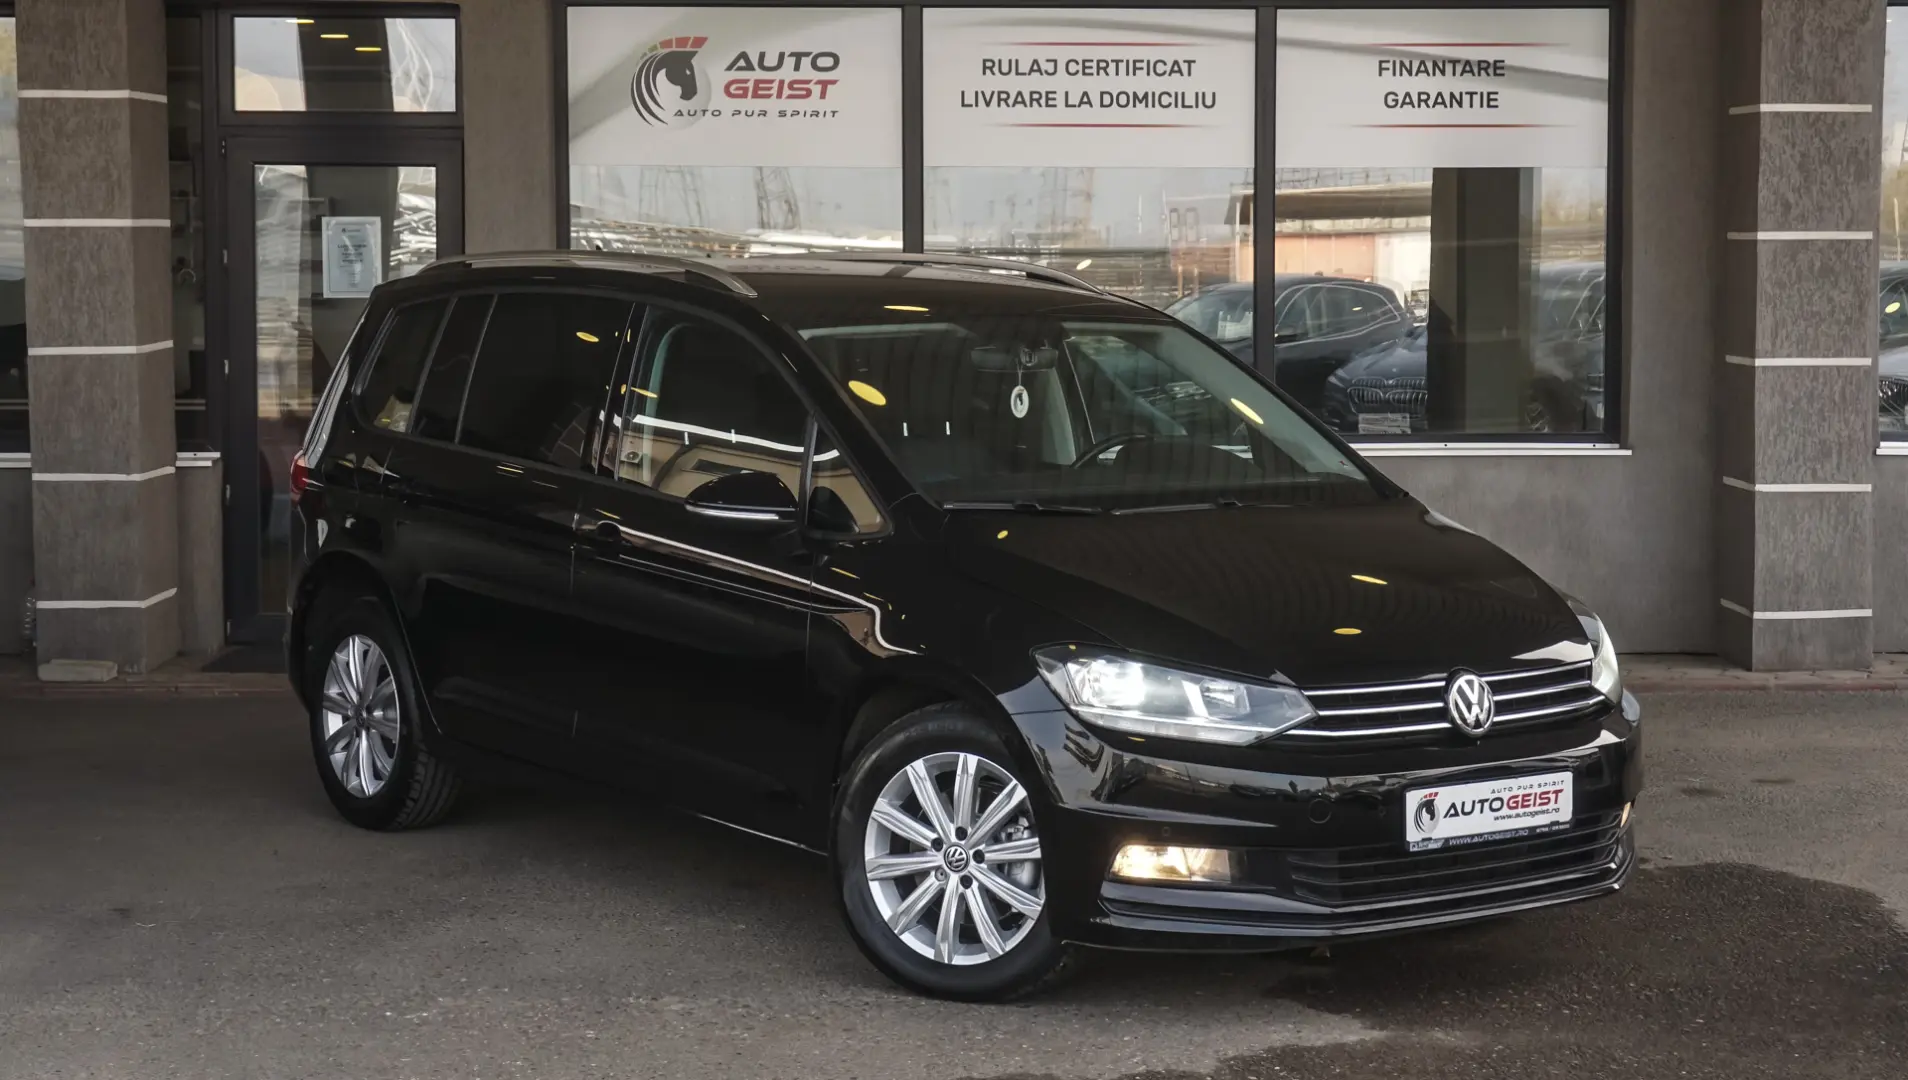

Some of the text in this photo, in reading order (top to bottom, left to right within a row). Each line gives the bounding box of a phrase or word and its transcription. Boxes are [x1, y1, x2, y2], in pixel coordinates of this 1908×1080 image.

[724, 50, 841, 73] AUTO
[981, 58, 1196, 78] RULAJ CERTIFICAT
[1378, 59, 1506, 77] FINANTARE
[723, 78, 840, 100] GEIST
[960, 90, 1217, 109] LIVRARE LA DOMICILIU
[1383, 91, 1499, 109] GARANTIE
[673, 109, 839, 118] AUTO PUR SPIRIT
[1490, 780, 1565, 795] AUTO PUR SPIRIT
[1442, 788, 1564, 820] AUTOGEIST
[1493, 807, 1560, 822] www.autogeist.ro
[1449, 829, 1529, 847] WWW.AUTOGEIST.RO
